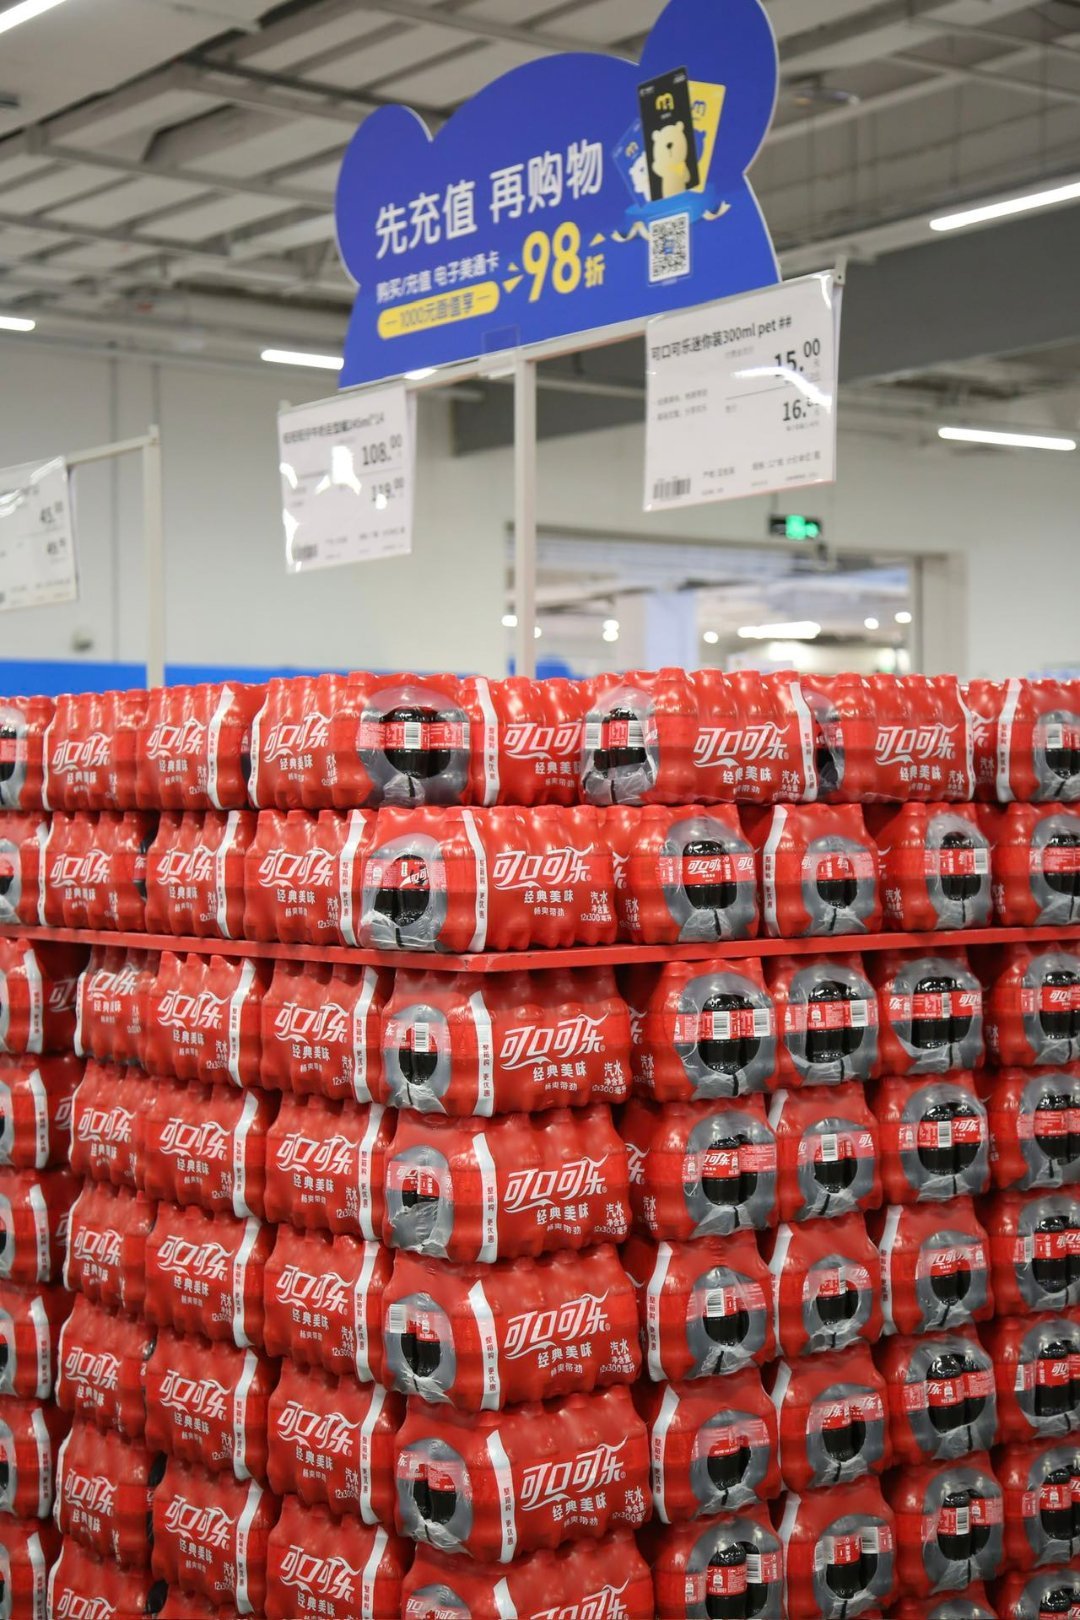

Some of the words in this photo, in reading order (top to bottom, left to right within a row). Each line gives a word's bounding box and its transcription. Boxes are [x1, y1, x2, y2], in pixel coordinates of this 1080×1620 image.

[375, 180, 478, 260] 先充值
[489, 139, 602, 224] 再购物
[522, 221, 581, 303] 98
[584, 254, 605, 288] 折
[758, 321, 776, 338] pet
[264, 711, 336, 762] 可口可乐
[693, 721, 790, 767] 可口可乐
[875, 723, 958, 765] 可口可乐
[782, 771, 800, 784] 汽水
[949, 771, 964, 784] 汽水
[258, 848, 336, 888] 可口可乐
[493, 843, 593, 891] 可口可乐
[277, 888, 316, 904] 经典美味
[524, 890, 574, 904] 经典美味
[591, 891, 608, 903] 汽水
[157, 989, 229, 1029] 可口可乐
[275, 1002, 349, 1043] 可口可乐
[173, 1029, 205, 1045] 经典美味
[500, 1012, 609, 1070] 可口可乐
[292, 1044, 330, 1061] 经典美味
[532, 1061, 587, 1081] 经典美味
[604, 1060, 622, 1076] 汽水
[545, 1081, 577, 1091] 畅爽带劲
[160, 1118, 231, 1160] 可口可乐
[177, 1158, 209, 1174] 经典美味
[277, 1133, 359, 1174] 可口可乐
[293, 1174, 334, 1192] 经典美味
[504, 1154, 608, 1213] 可口可乐
[537, 1202, 589, 1224] 经典美味
[606, 1201, 623, 1217] 汽水
[157, 1236, 234, 1280] 可口可乐
[173, 1276, 209, 1296] 经典美味
[276, 1265, 354, 1310] 可口可乐
[292, 1310, 329, 1329] 经典美味
[504, 1289, 609, 1359] 可口可乐
[537, 1342, 592, 1369] 经典美味
[610, 1339, 628, 1355] 汽水
[488, 1367, 496, 1391] 更优惠
[160, 1370, 231, 1418] 可口可乐
[174, 1412, 209, 1434] 经典美味
[278, 1401, 359, 1455] 可口可乐
[296, 1446, 333, 1470] 经典美味
[521, 1436, 628, 1511] 可口可乐
[504, 1487, 512, 1512] 整箱购
[552, 1492, 607, 1521] 经典美味
[625, 1486, 644, 1504] 汽水
[166, 1494, 234, 1549] 可口可乐
[505, 1519, 513, 1545] 更优惠
[179, 1538, 212, 1564] 经典美味
[280, 1545, 360, 1603] 可口可乐
[297, 1591, 336, 1617] 经典美味
